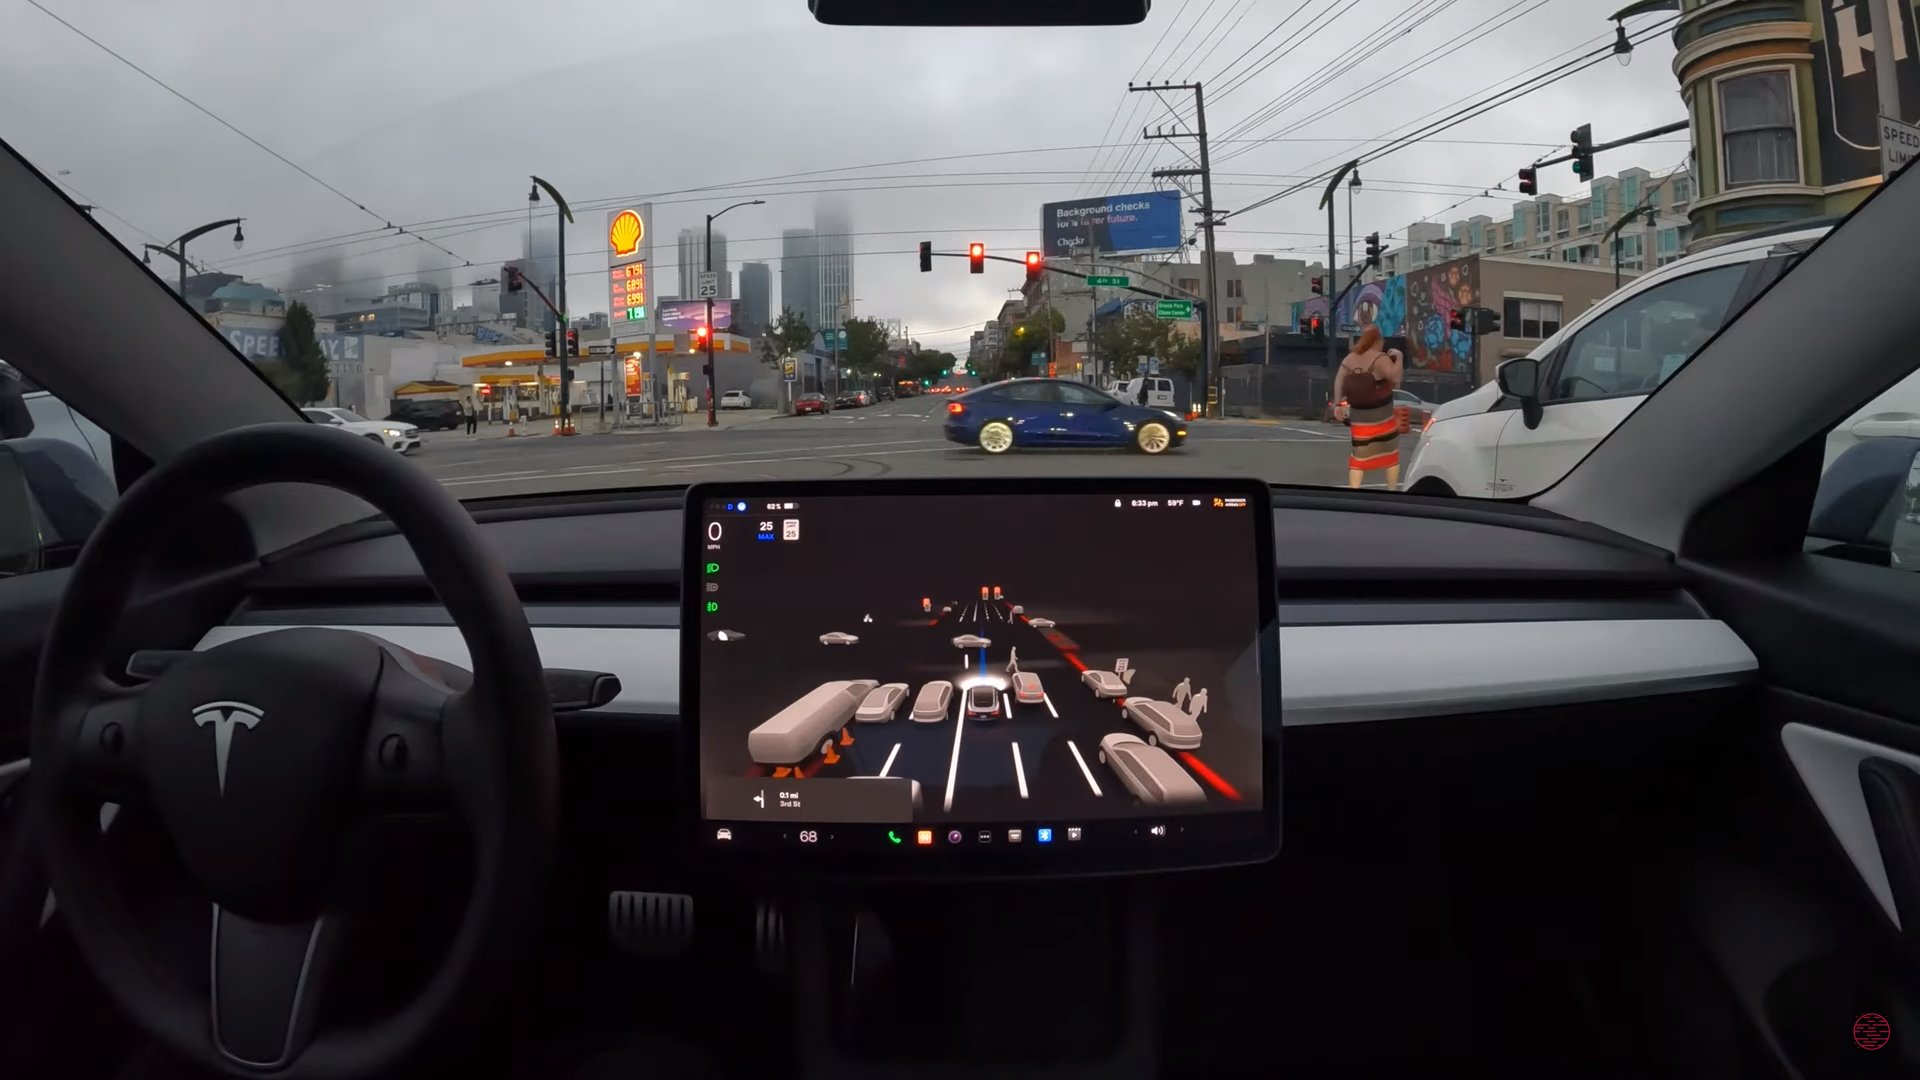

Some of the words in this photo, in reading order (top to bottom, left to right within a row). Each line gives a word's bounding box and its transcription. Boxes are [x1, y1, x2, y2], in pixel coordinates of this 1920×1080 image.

[1884, 126, 1920, 148] SPEED
[1888, 150, 1916, 165] LIMI
[1056, 204, 1113, 217] Background
[1115, 201, 1151, 213] checks
[1107, 213, 1138, 224] future.
[701, 286, 716, 296] 25
[708, 522, 722, 541] 0
[760, 522, 773, 531] 25
[800, 831, 817, 842] 68
